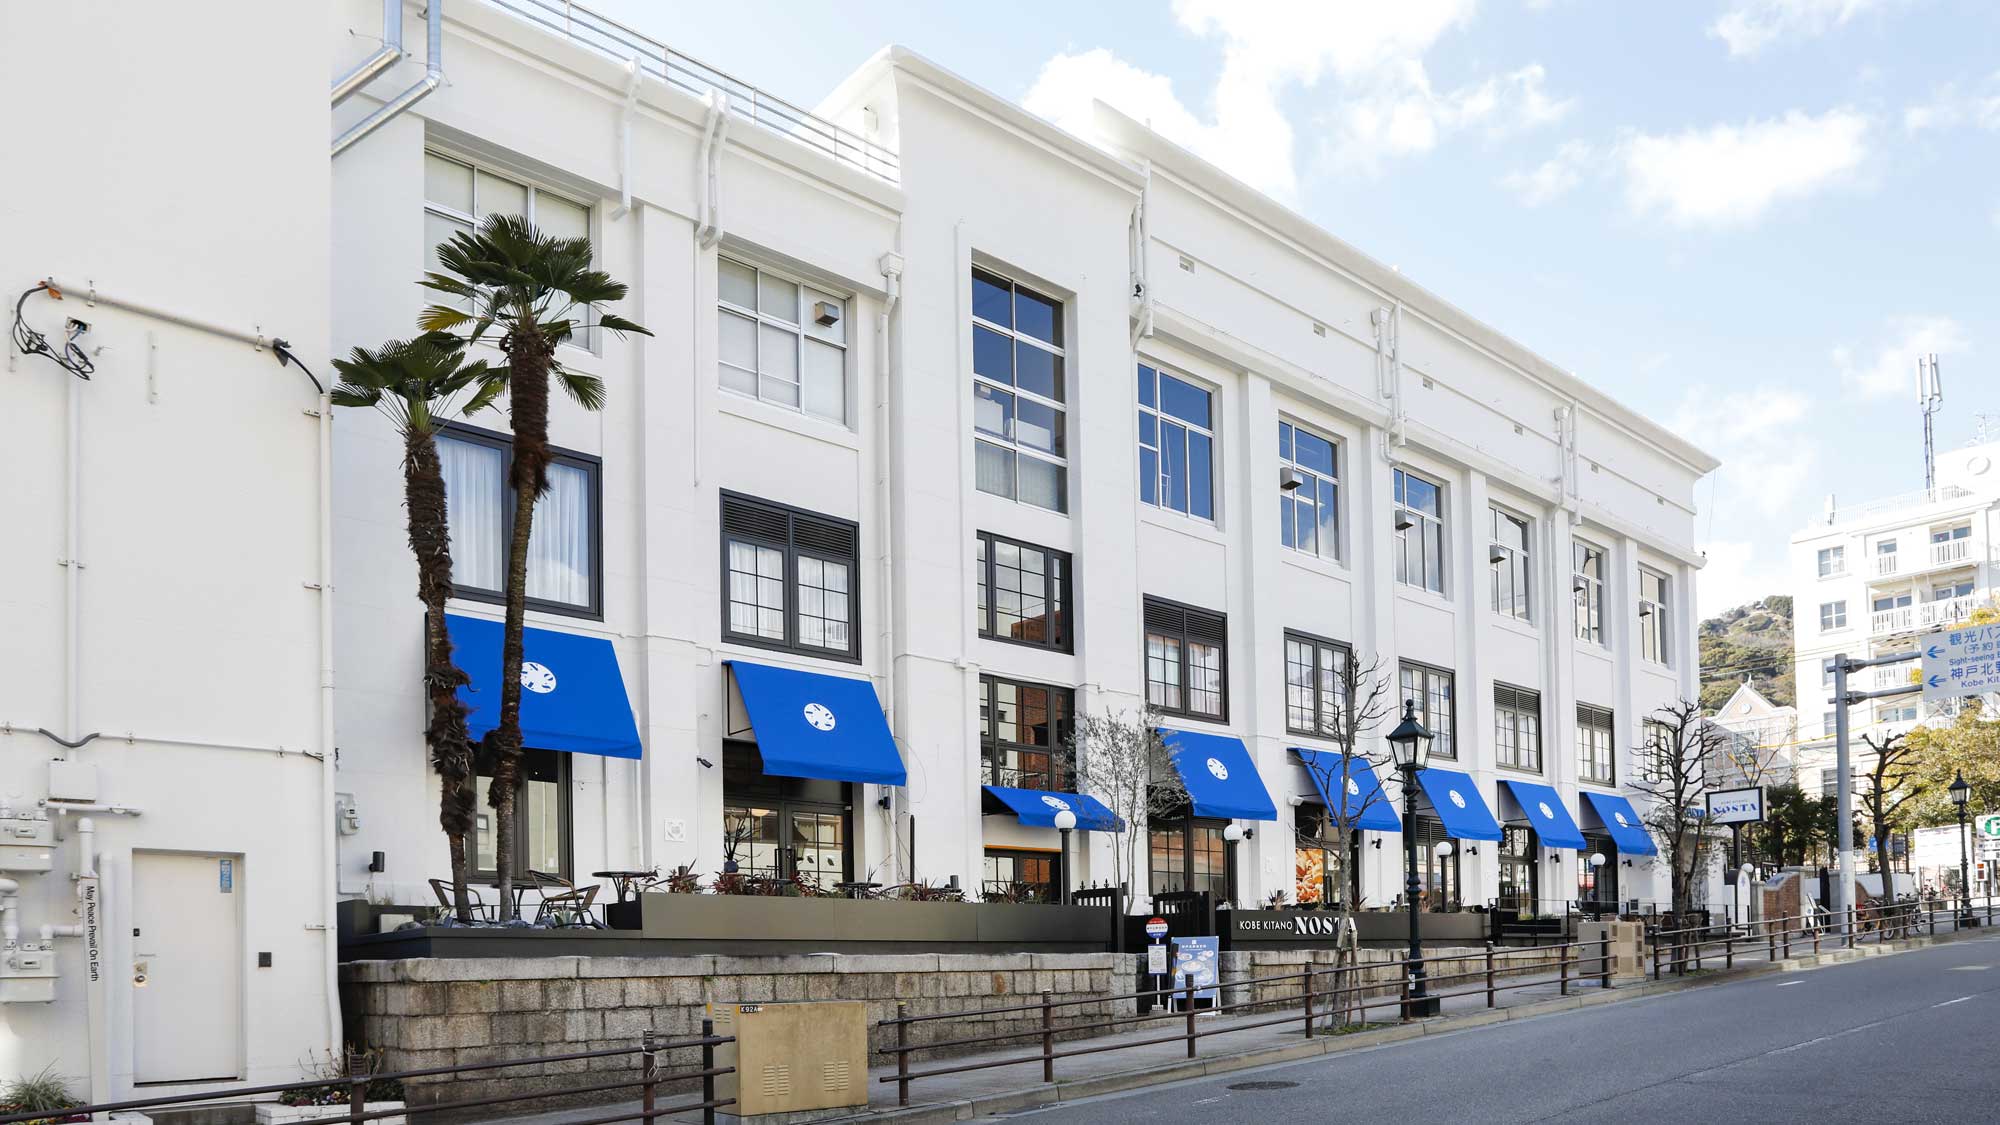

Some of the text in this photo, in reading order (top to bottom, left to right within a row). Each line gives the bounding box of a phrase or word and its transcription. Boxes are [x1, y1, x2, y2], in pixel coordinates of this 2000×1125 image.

[1950, 654, 1994, 666] Sight-seeing
[1961, 680, 1984, 688] Kobe
[1713, 803, 1757, 814] NOSTA
[1240, 920, 1260, 930] KOBE
[1263, 920, 1292, 930] KITANO
[85, 886, 99, 982] May Peace Prevail On Earth
